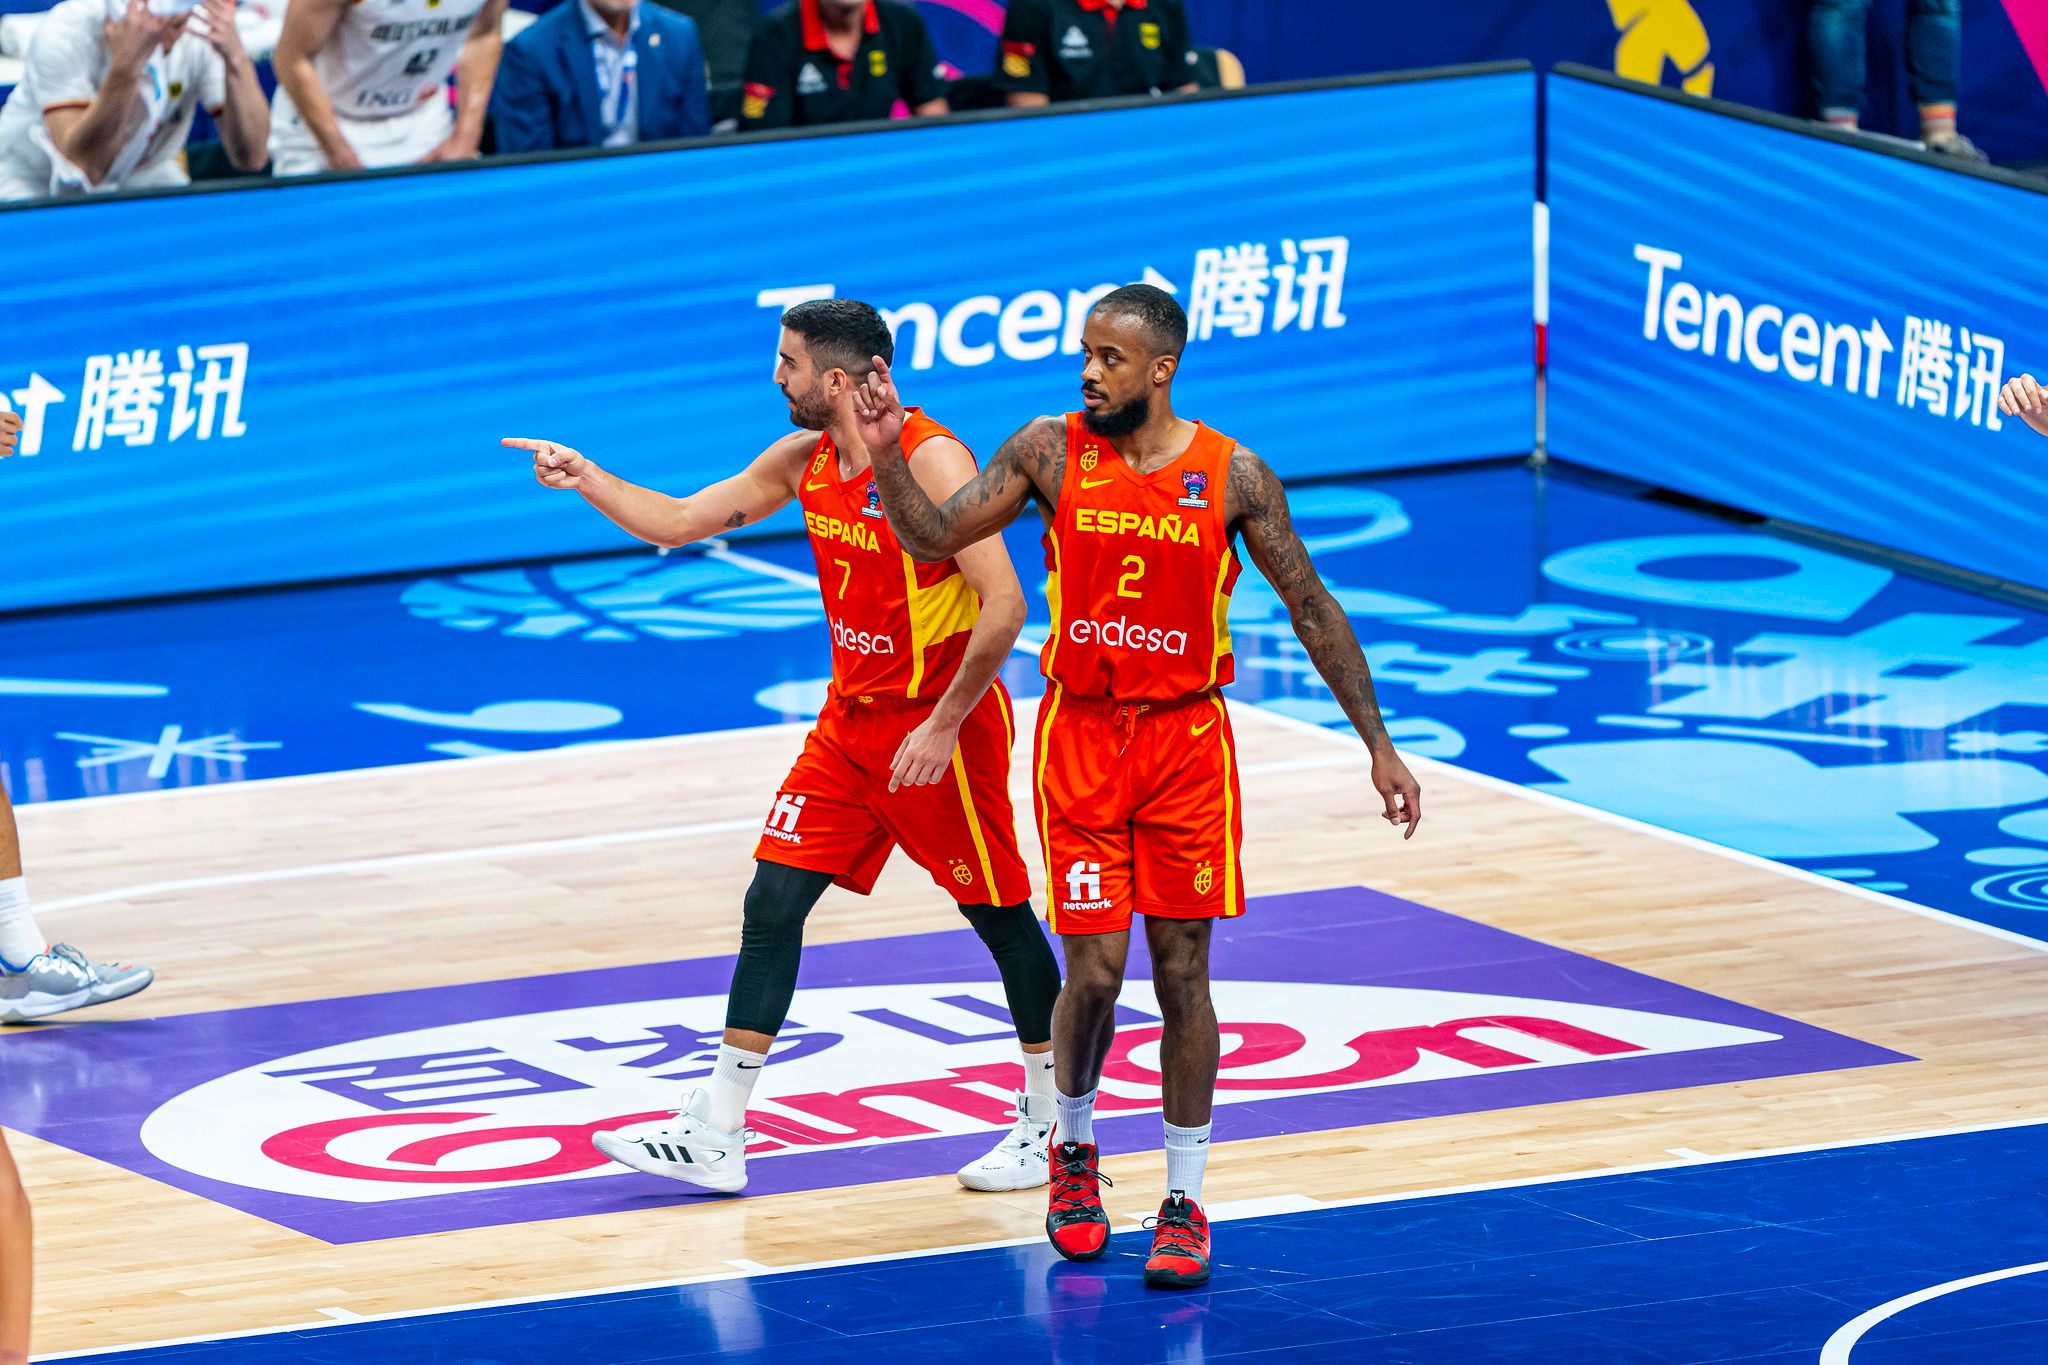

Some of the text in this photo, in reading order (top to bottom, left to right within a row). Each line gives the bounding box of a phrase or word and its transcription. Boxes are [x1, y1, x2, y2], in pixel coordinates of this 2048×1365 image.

[1187, 236, 1349, 343] 腾讯
[1634, 244, 2005, 432] Tencent 腾讯
[72, 342, 249, 451] 腾讯
[804, 510, 881, 554] ESPAÑA
[1076, 508, 1200, 547] ESPAÑA
[834, 558, 852, 600] 7
[1116, 554, 1146, 599] 2
[1069, 615, 1188, 656] endesa
[767, 793, 807, 833] fi
[1065, 860, 1101, 901] fi
[1062, 897, 1112, 911] network
